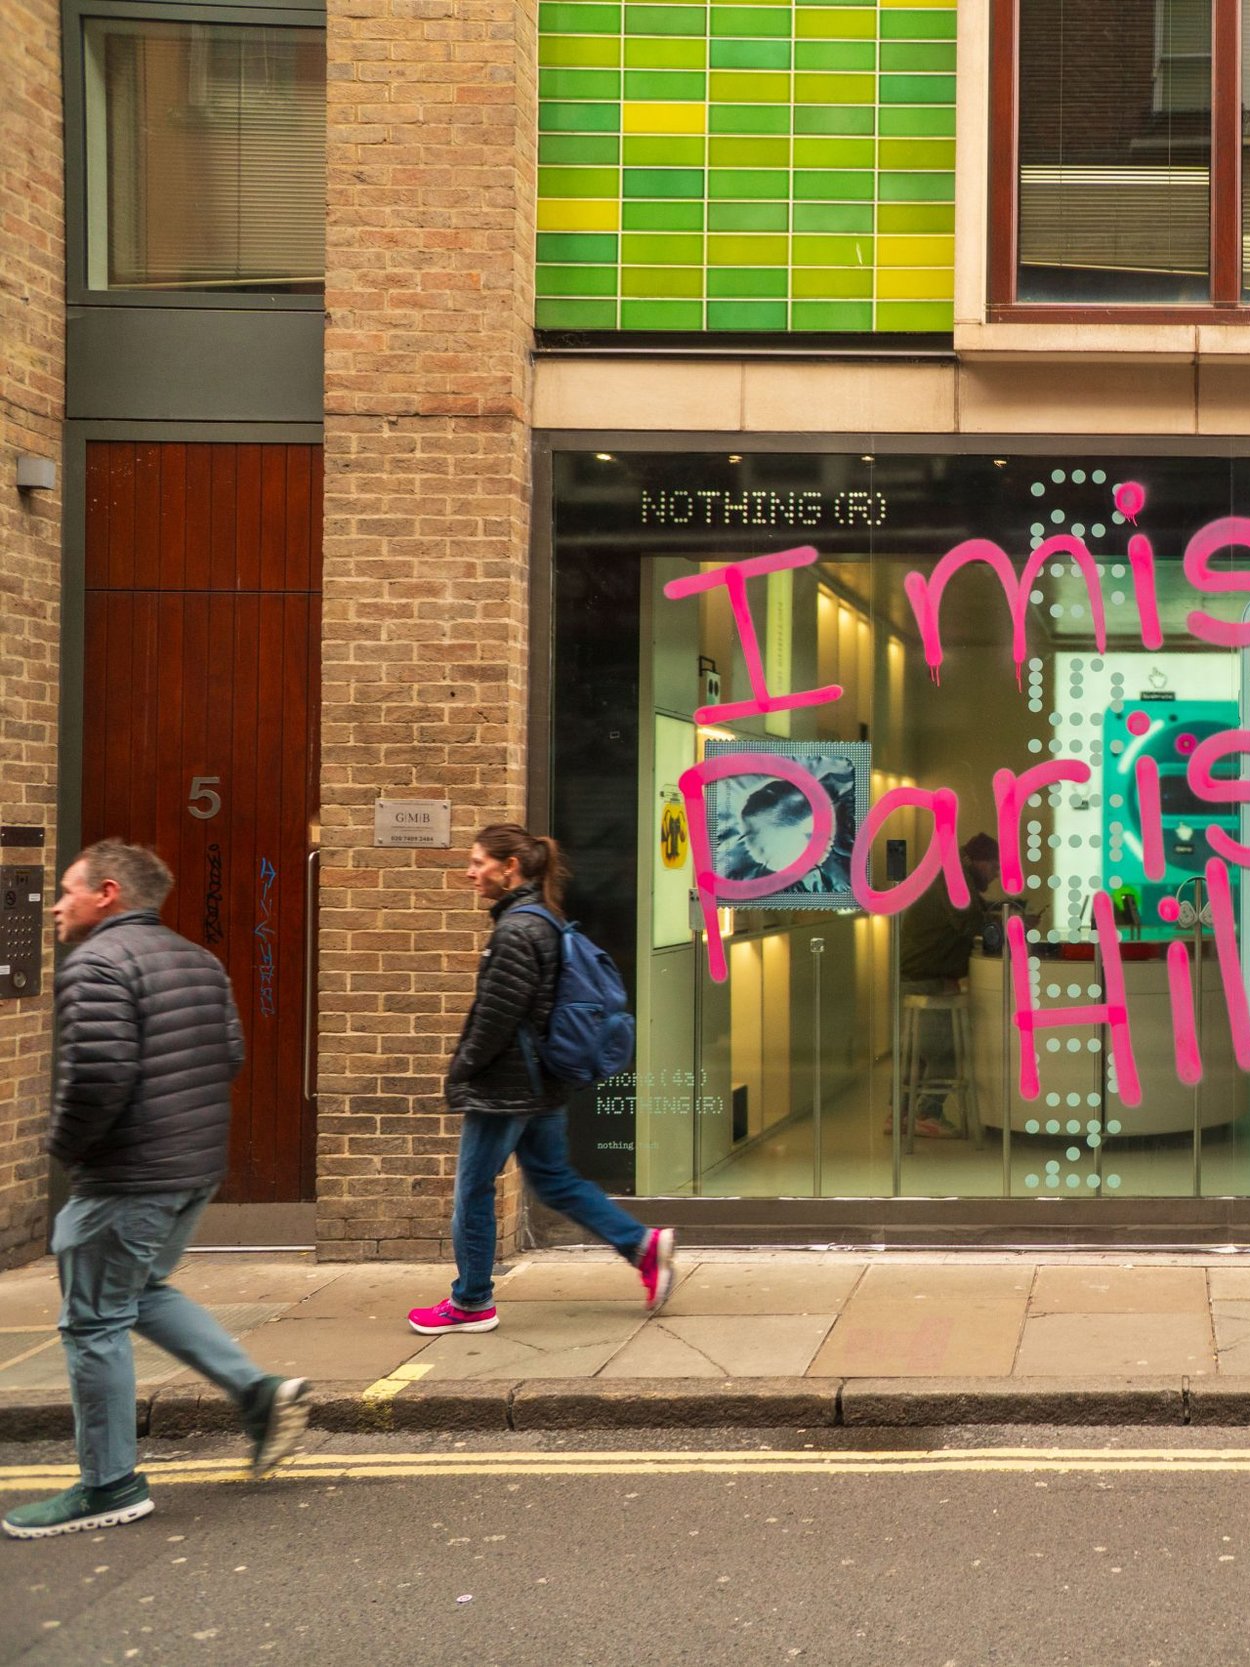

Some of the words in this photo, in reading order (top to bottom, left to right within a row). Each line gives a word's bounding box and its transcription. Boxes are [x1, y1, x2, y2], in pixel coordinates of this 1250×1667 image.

[642, 490, 822, 524] NOTHING
[664, 545, 843, 725] I
[187, 776, 222, 820] 5
[597, 1097, 690, 1114] NOTHING
